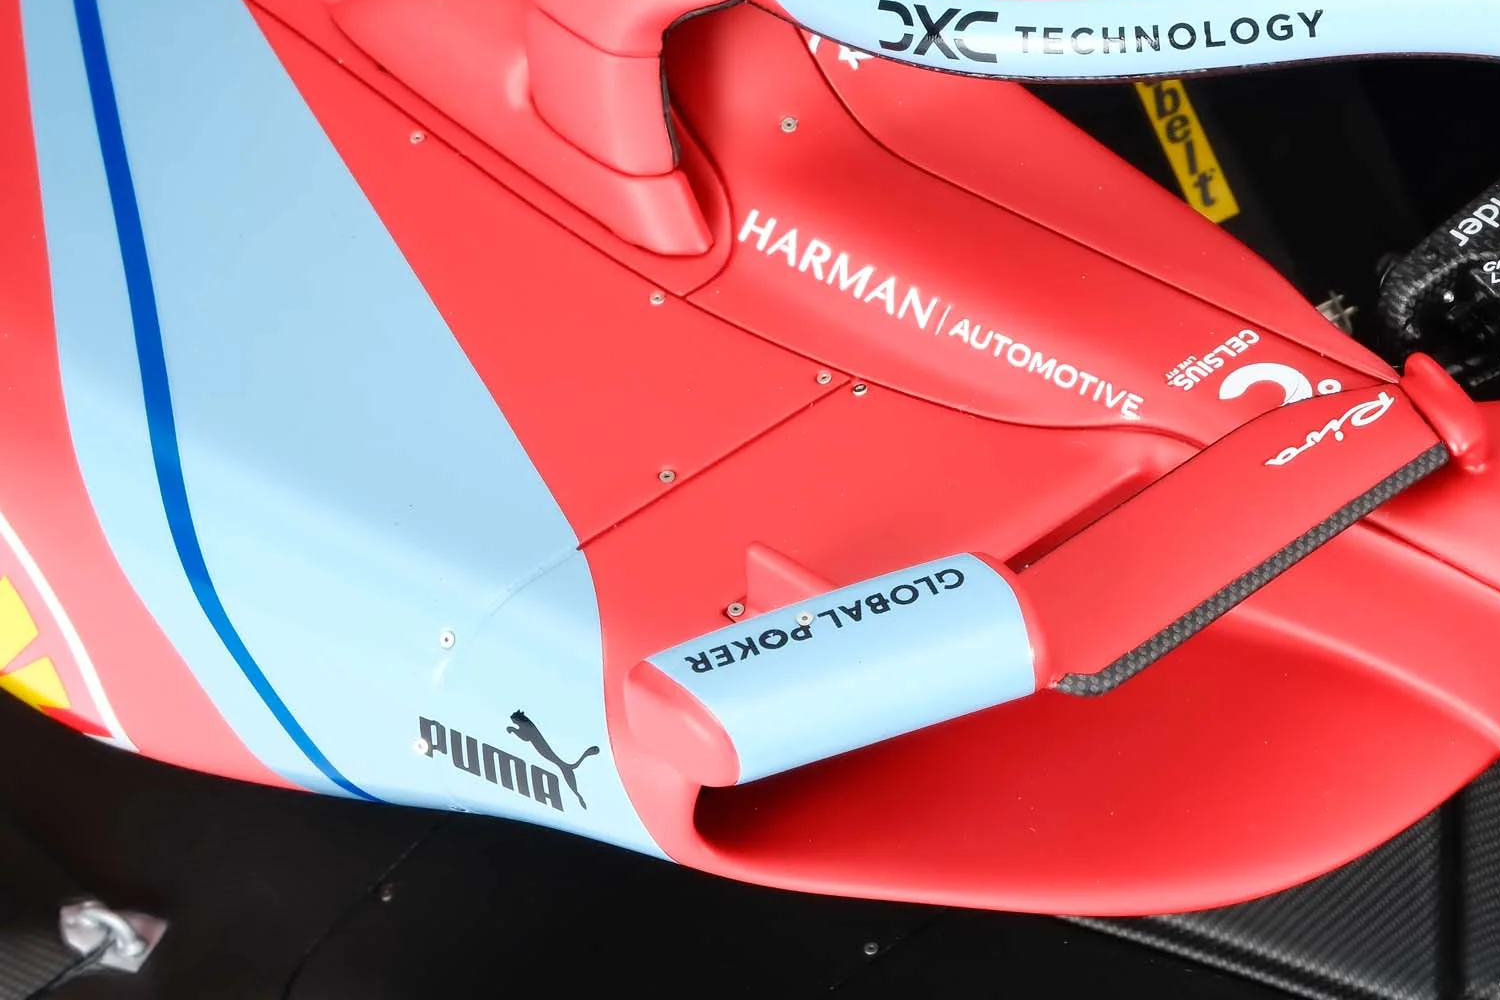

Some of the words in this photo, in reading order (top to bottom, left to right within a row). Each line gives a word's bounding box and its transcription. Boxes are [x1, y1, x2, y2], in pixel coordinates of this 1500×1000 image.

[1014, 9, 1324, 56] TECHNOLOGY
[1153, 81, 1217, 208] belt
[738, 208, 940, 330] HARMAN
[949, 316, 1145, 421] AUTOMOTIVE
[1263, 391, 1395, 466] Riva
[817, 566, 965, 630] GLOBAL
[684, 622, 813, 676] POKER
[417, 715, 565, 812] PUMA
